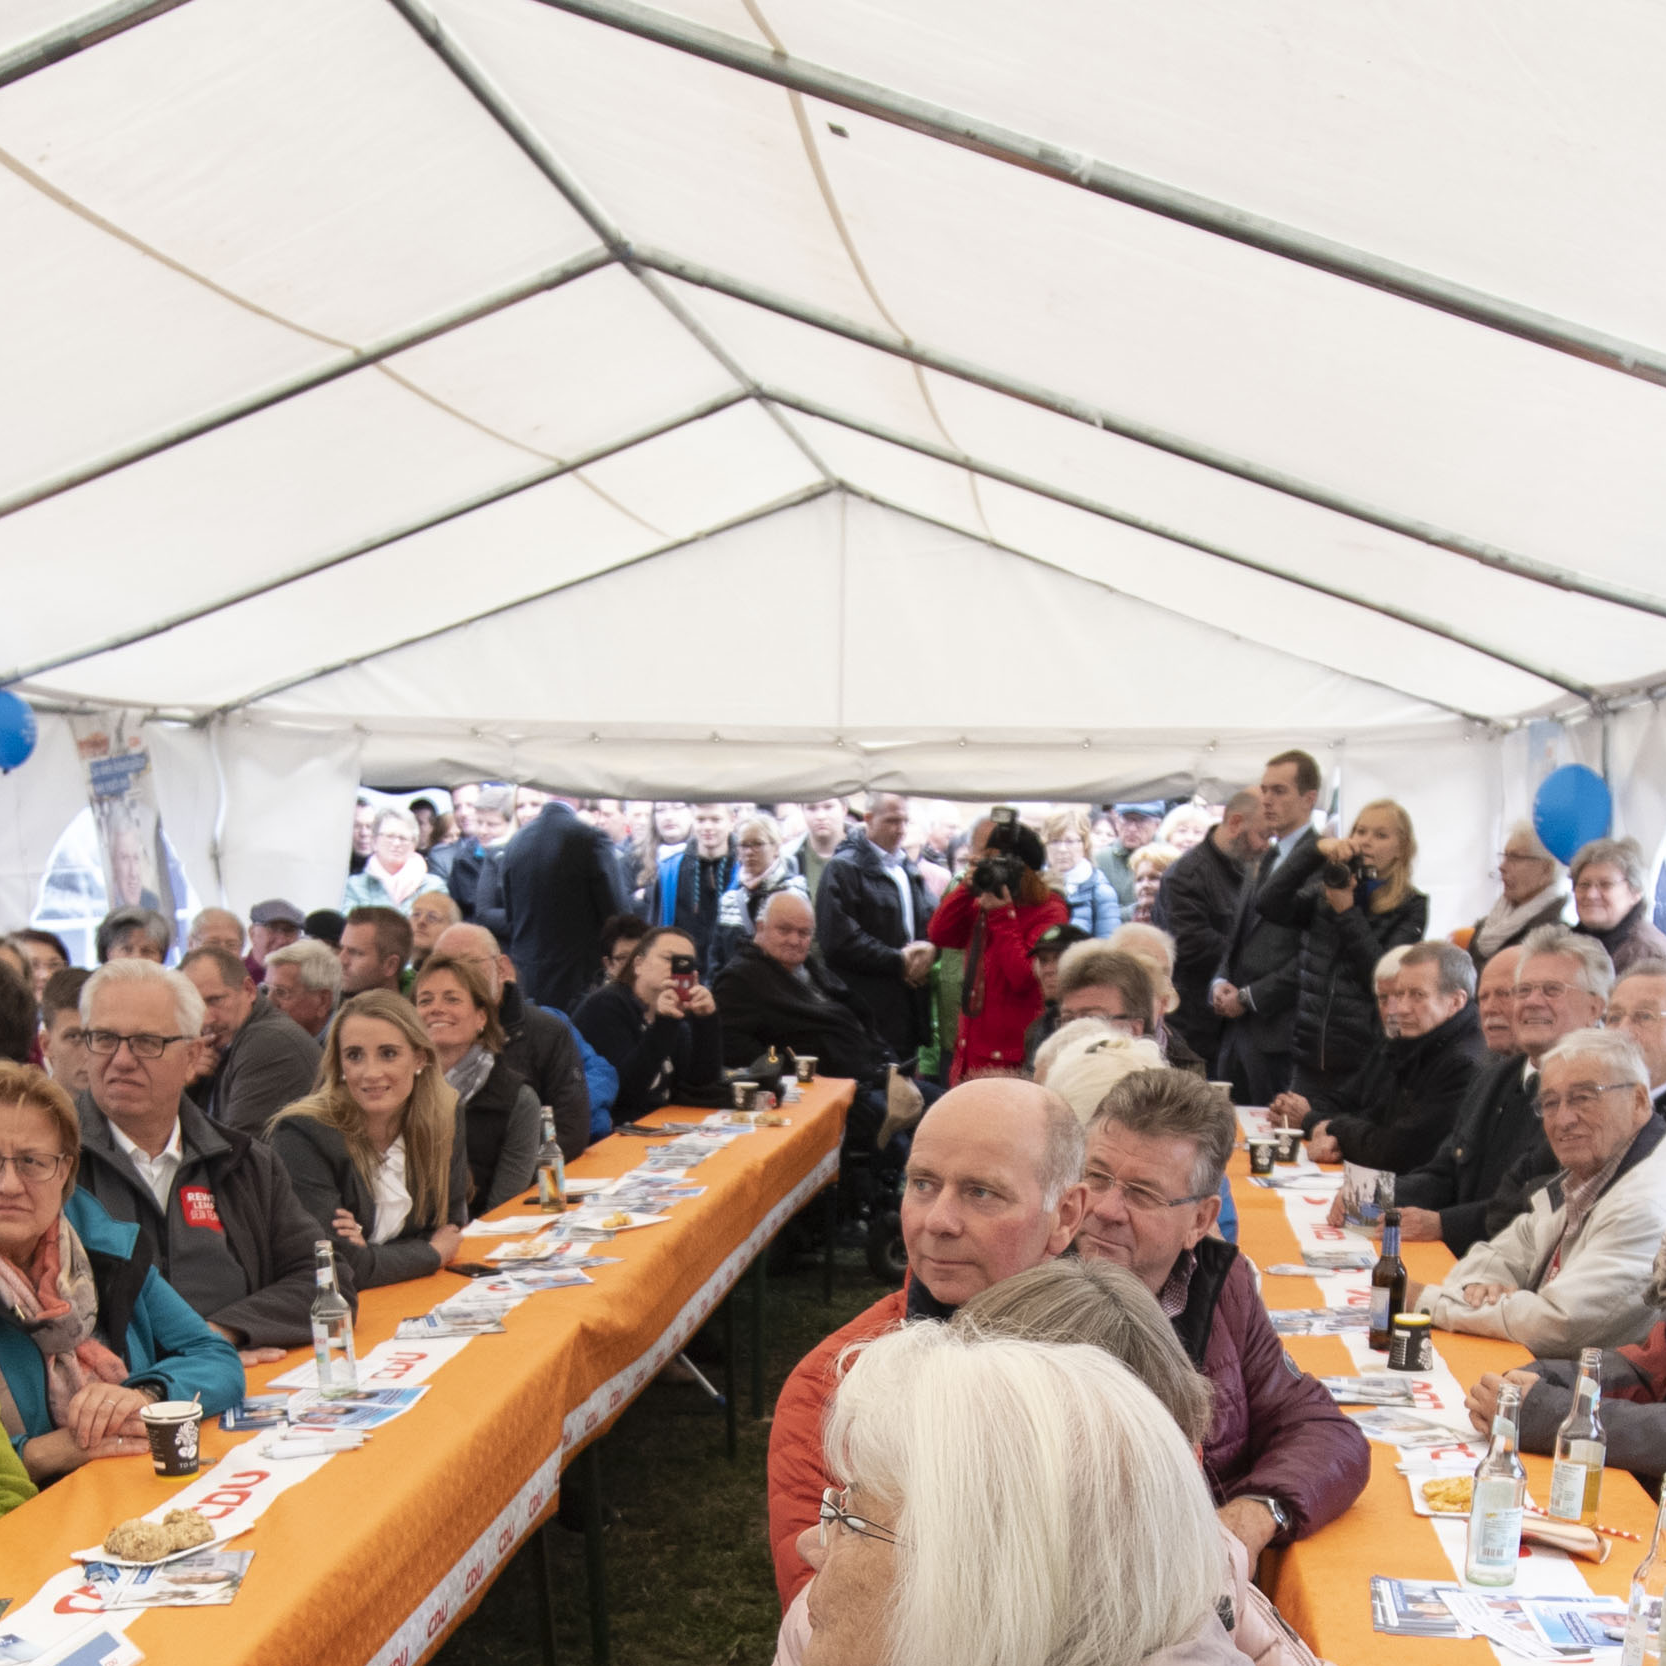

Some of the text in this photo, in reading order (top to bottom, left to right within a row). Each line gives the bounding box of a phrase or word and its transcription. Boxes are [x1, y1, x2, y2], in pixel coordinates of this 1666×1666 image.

[370, 1351, 429, 1380] CDU
[192, 1469, 271, 1520] CDU
[528, 1488, 544, 1518] CDU
[498, 1522, 516, 1555] CDU
[465, 1558, 484, 1594] CDU
[427, 1600, 449, 1638] CDU
